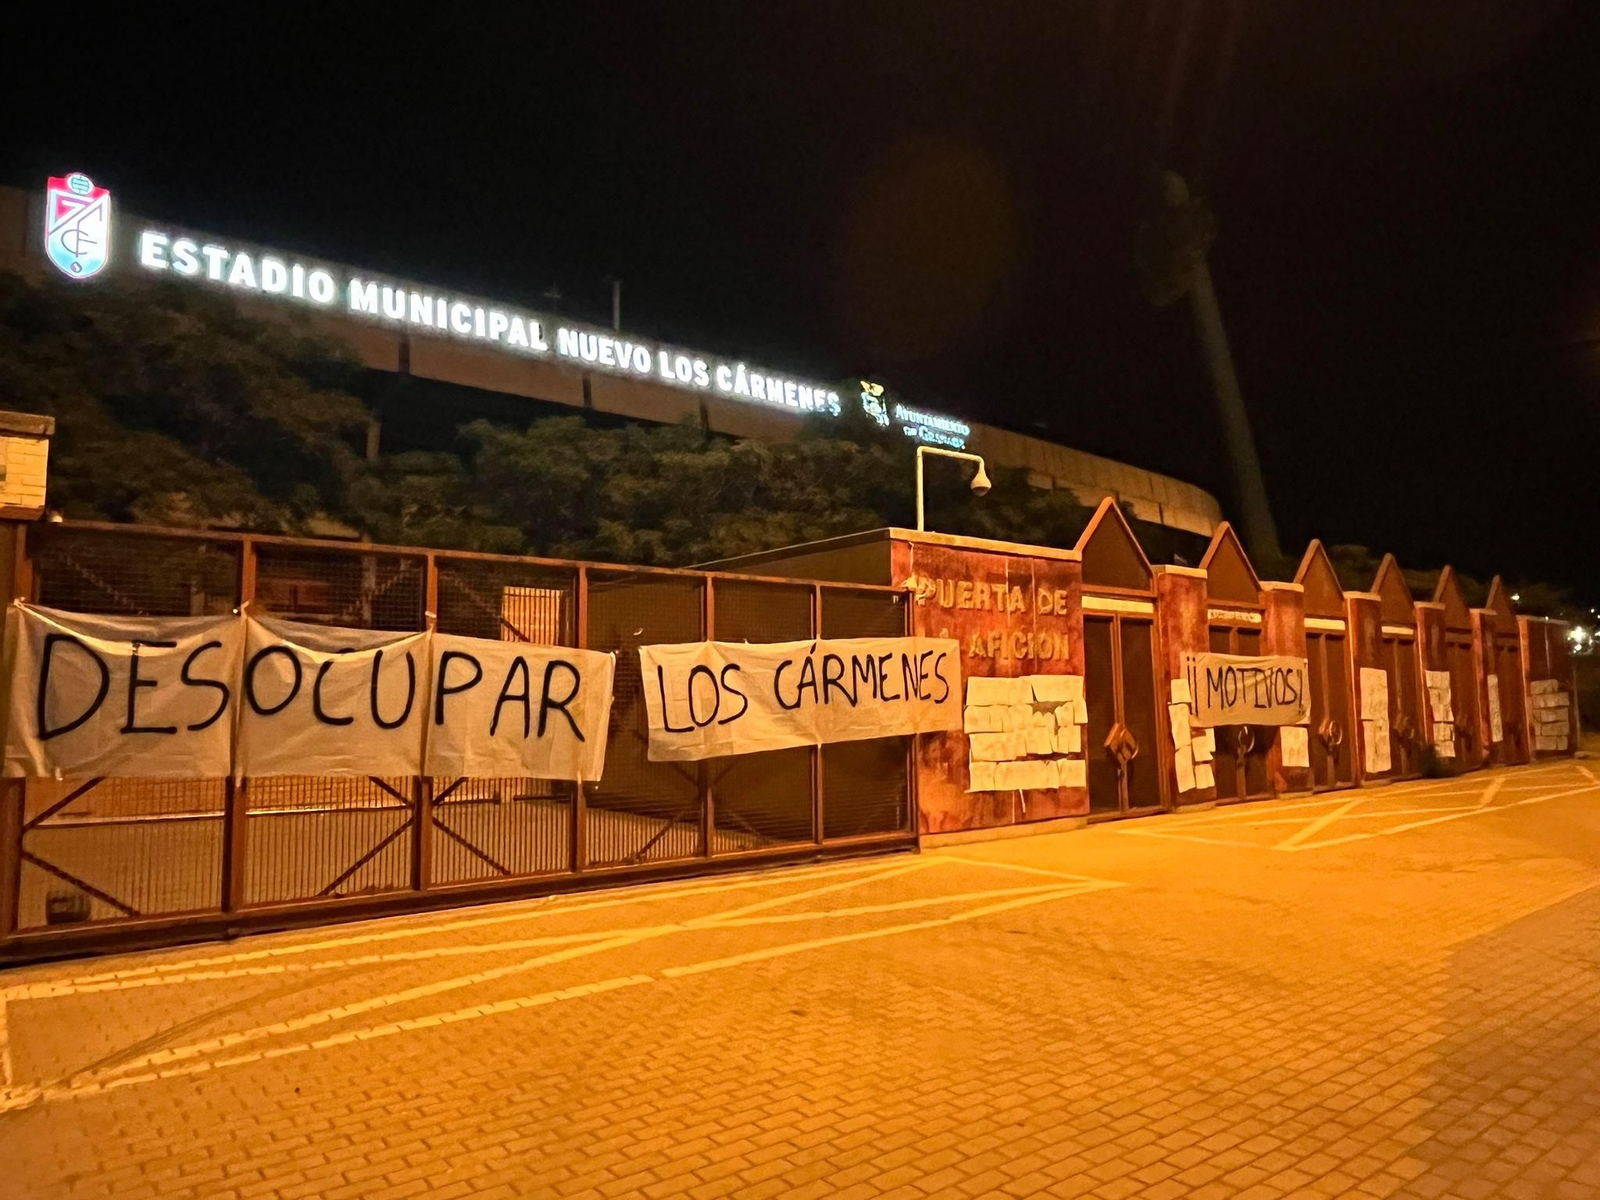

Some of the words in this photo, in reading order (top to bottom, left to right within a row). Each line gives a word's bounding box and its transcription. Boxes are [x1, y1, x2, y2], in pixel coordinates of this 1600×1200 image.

[140, 231, 335, 303] ESTADIO
[349, 278, 549, 351] MUNICIPAL
[557, 327, 652, 373] NUEVO
[659, 350, 710, 387] LOS
[716, 361, 841, 416] CÁRMENES
[914, 574, 1026, 613] PUERTA
[1037, 588, 1068, 616] DE
[38, 633, 585, 742] DESOCUPAR
[657, 663, 748, 733] LOS
[774, 641, 950, 710] CÁRMENES
